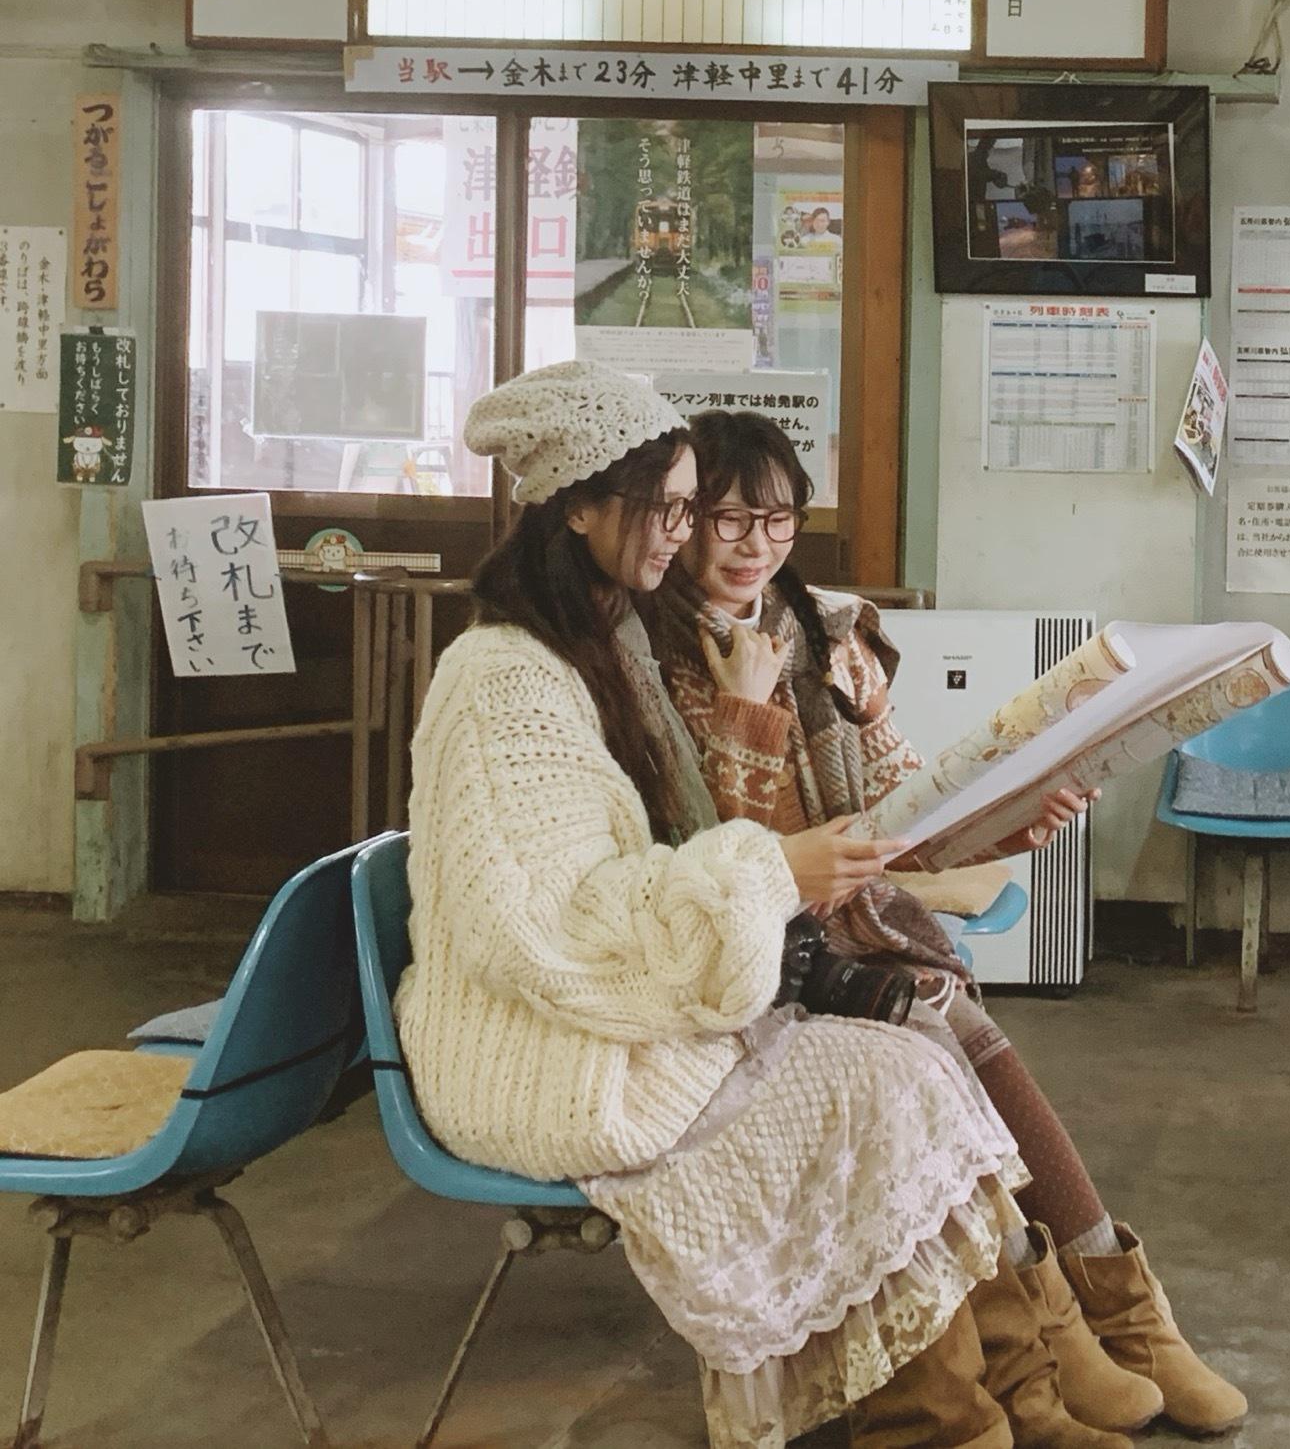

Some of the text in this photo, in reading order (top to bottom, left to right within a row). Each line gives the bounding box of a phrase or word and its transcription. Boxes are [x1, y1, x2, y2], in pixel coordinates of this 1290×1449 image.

[397, 57, 452, 83] 当駅
[673, 61, 904, 95] 津軽中里まで41分
[81, 103, 115, 302] つがるごしょがわら
[676, 138, 692, 297] 津軽鉄道はまだ大丈夫
[1029, 305, 1110, 317] 列車時刻表
[74, 341, 88, 424] お待ちください
[92, 341, 101, 416] もうしばらく
[112, 336, 132, 483] 改札しておりません
[658, 390, 819, 409] ワンマン列車では始発駅の
[167, 525, 216, 673] お待ち下さい
[210, 514, 275, 669] 改札まで
